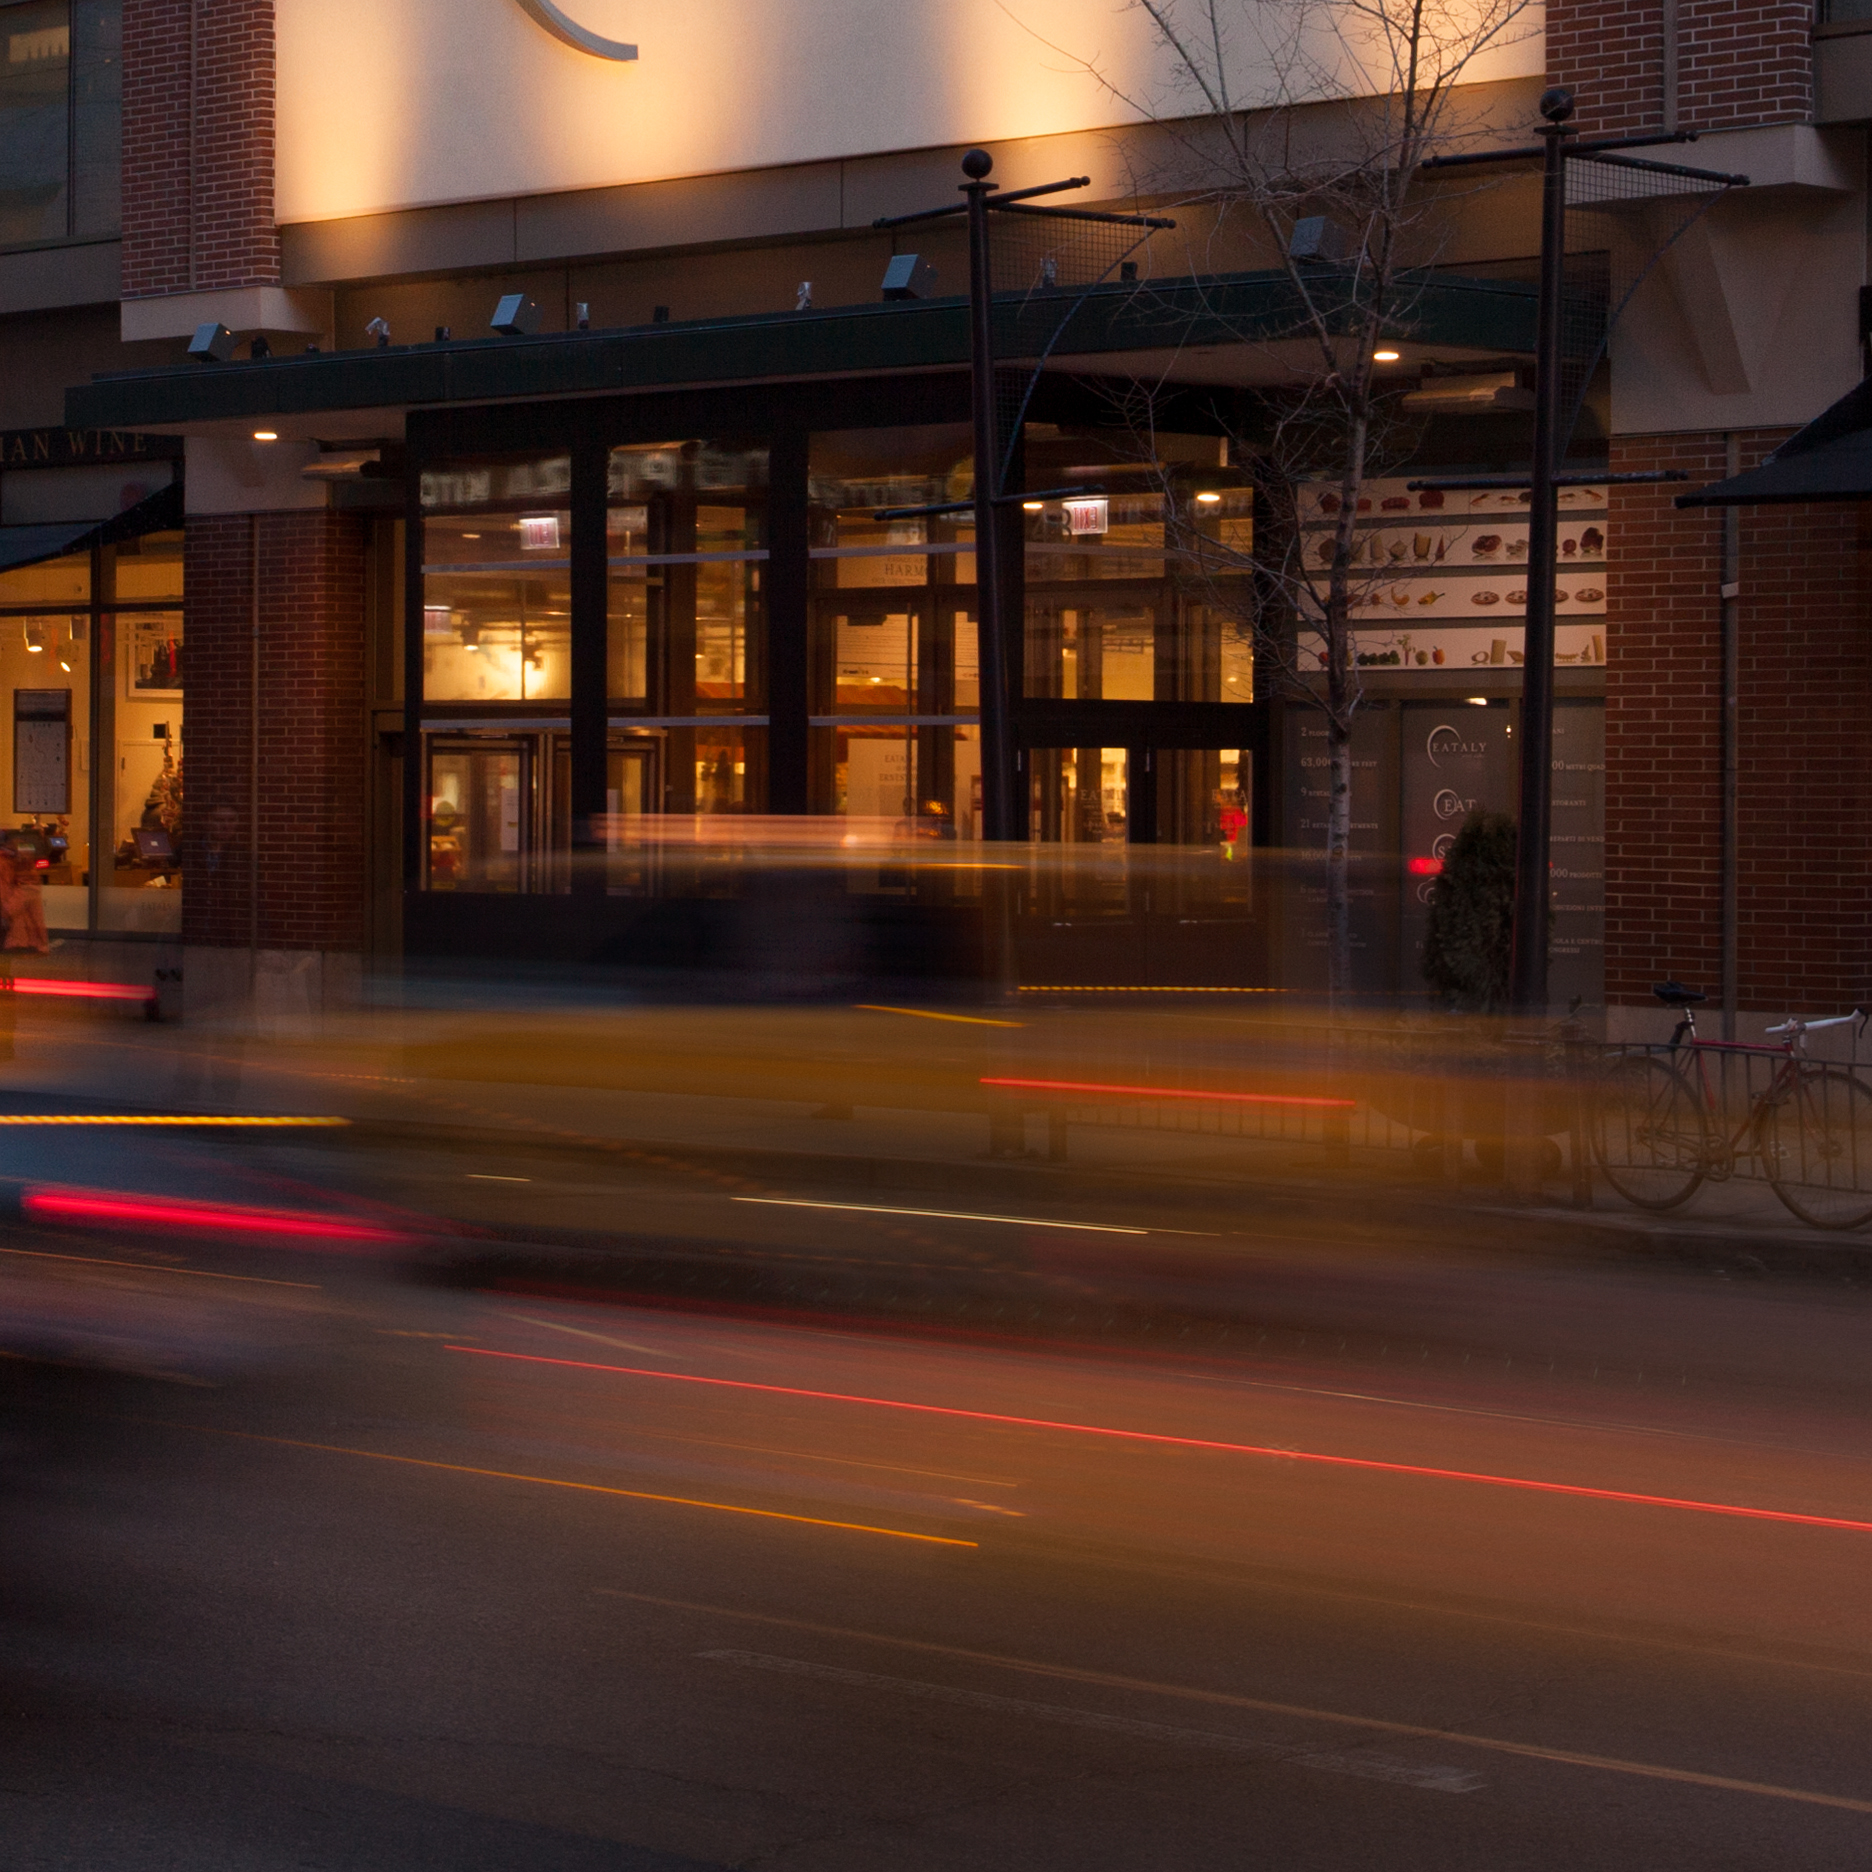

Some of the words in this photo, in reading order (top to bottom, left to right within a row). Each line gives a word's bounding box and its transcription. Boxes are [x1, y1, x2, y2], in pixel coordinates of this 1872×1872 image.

[68, 430, 148, 456] WINE
[1432, 743, 1486, 752] EATALY
[1444, 799, 1477, 812] EAT
